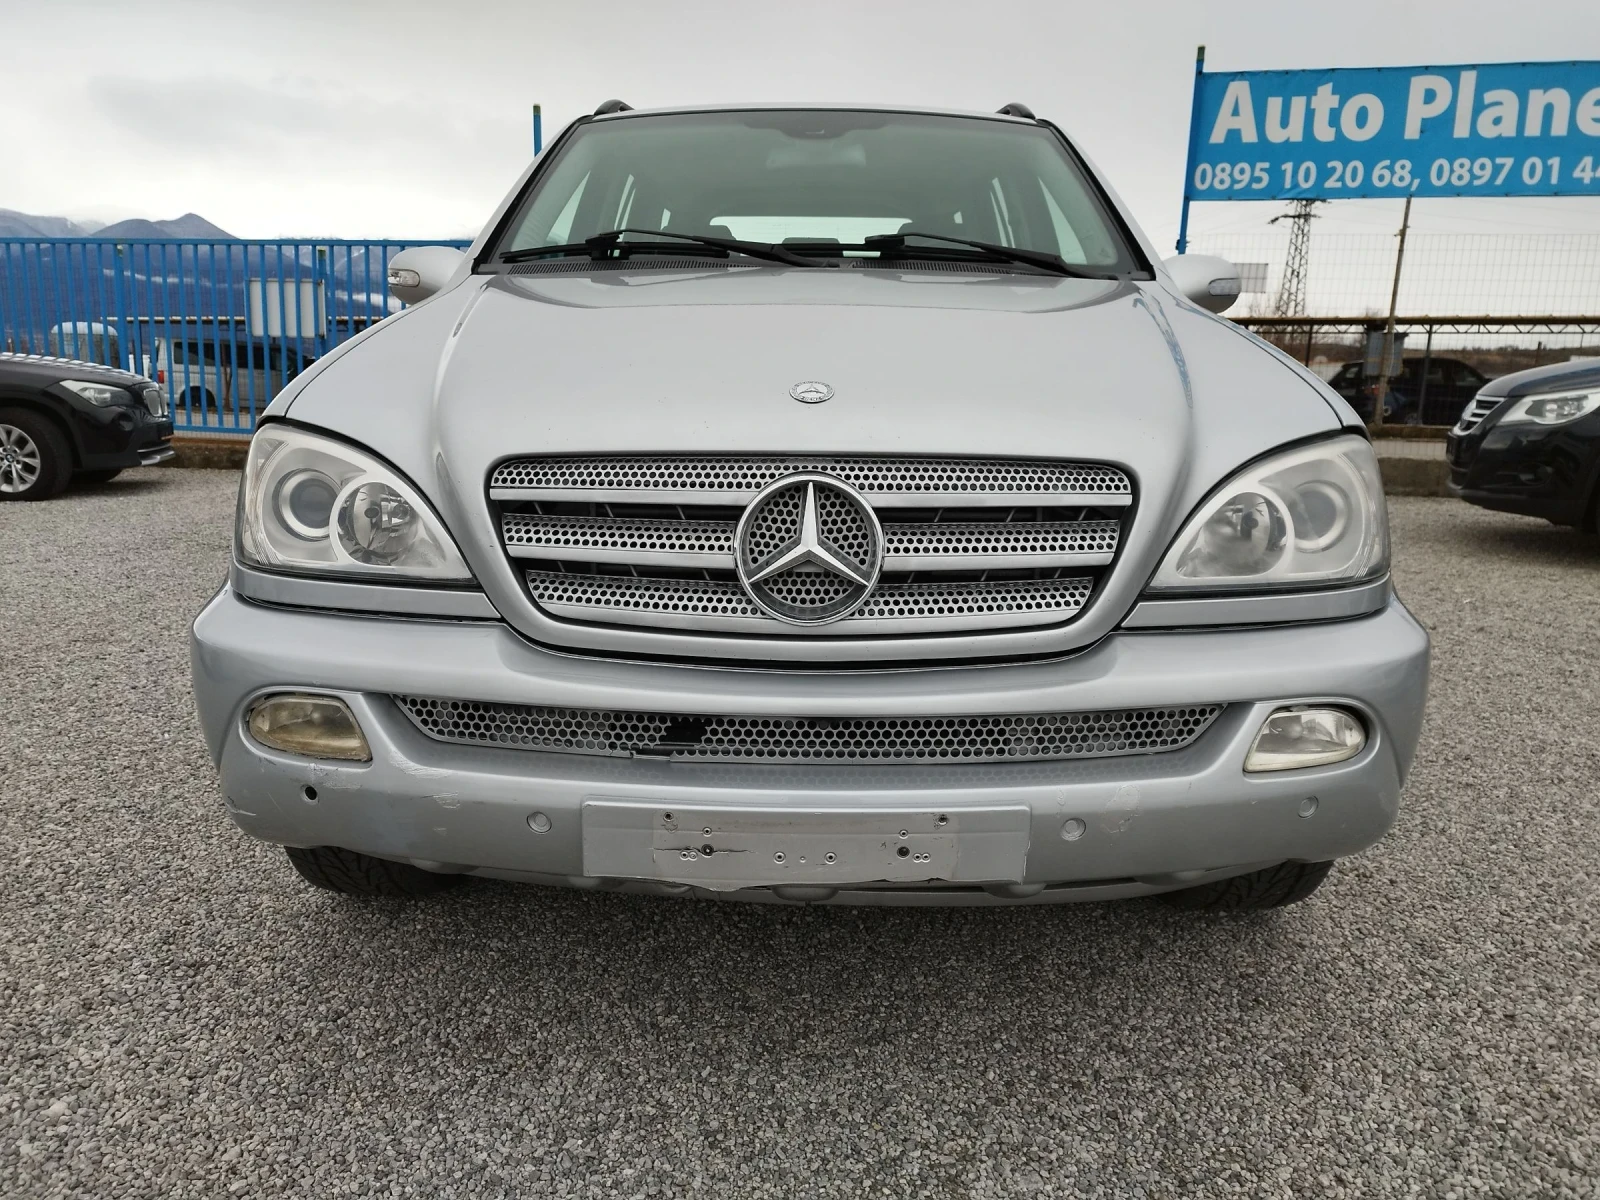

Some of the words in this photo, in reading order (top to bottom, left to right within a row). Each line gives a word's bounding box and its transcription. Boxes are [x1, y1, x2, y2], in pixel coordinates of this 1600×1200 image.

[1209, 81, 1384, 143] Auto
[1195, 162, 1270, 190] 0895
[1281, 162, 1317, 189] 10
[1324, 160, 1364, 188] 20
[1372, 159, 1420, 191] 68,
[1430, 157, 1514, 186] 0897
[1522, 156, 1561, 185] 01
[1572, 155, 1600, 184] 4
